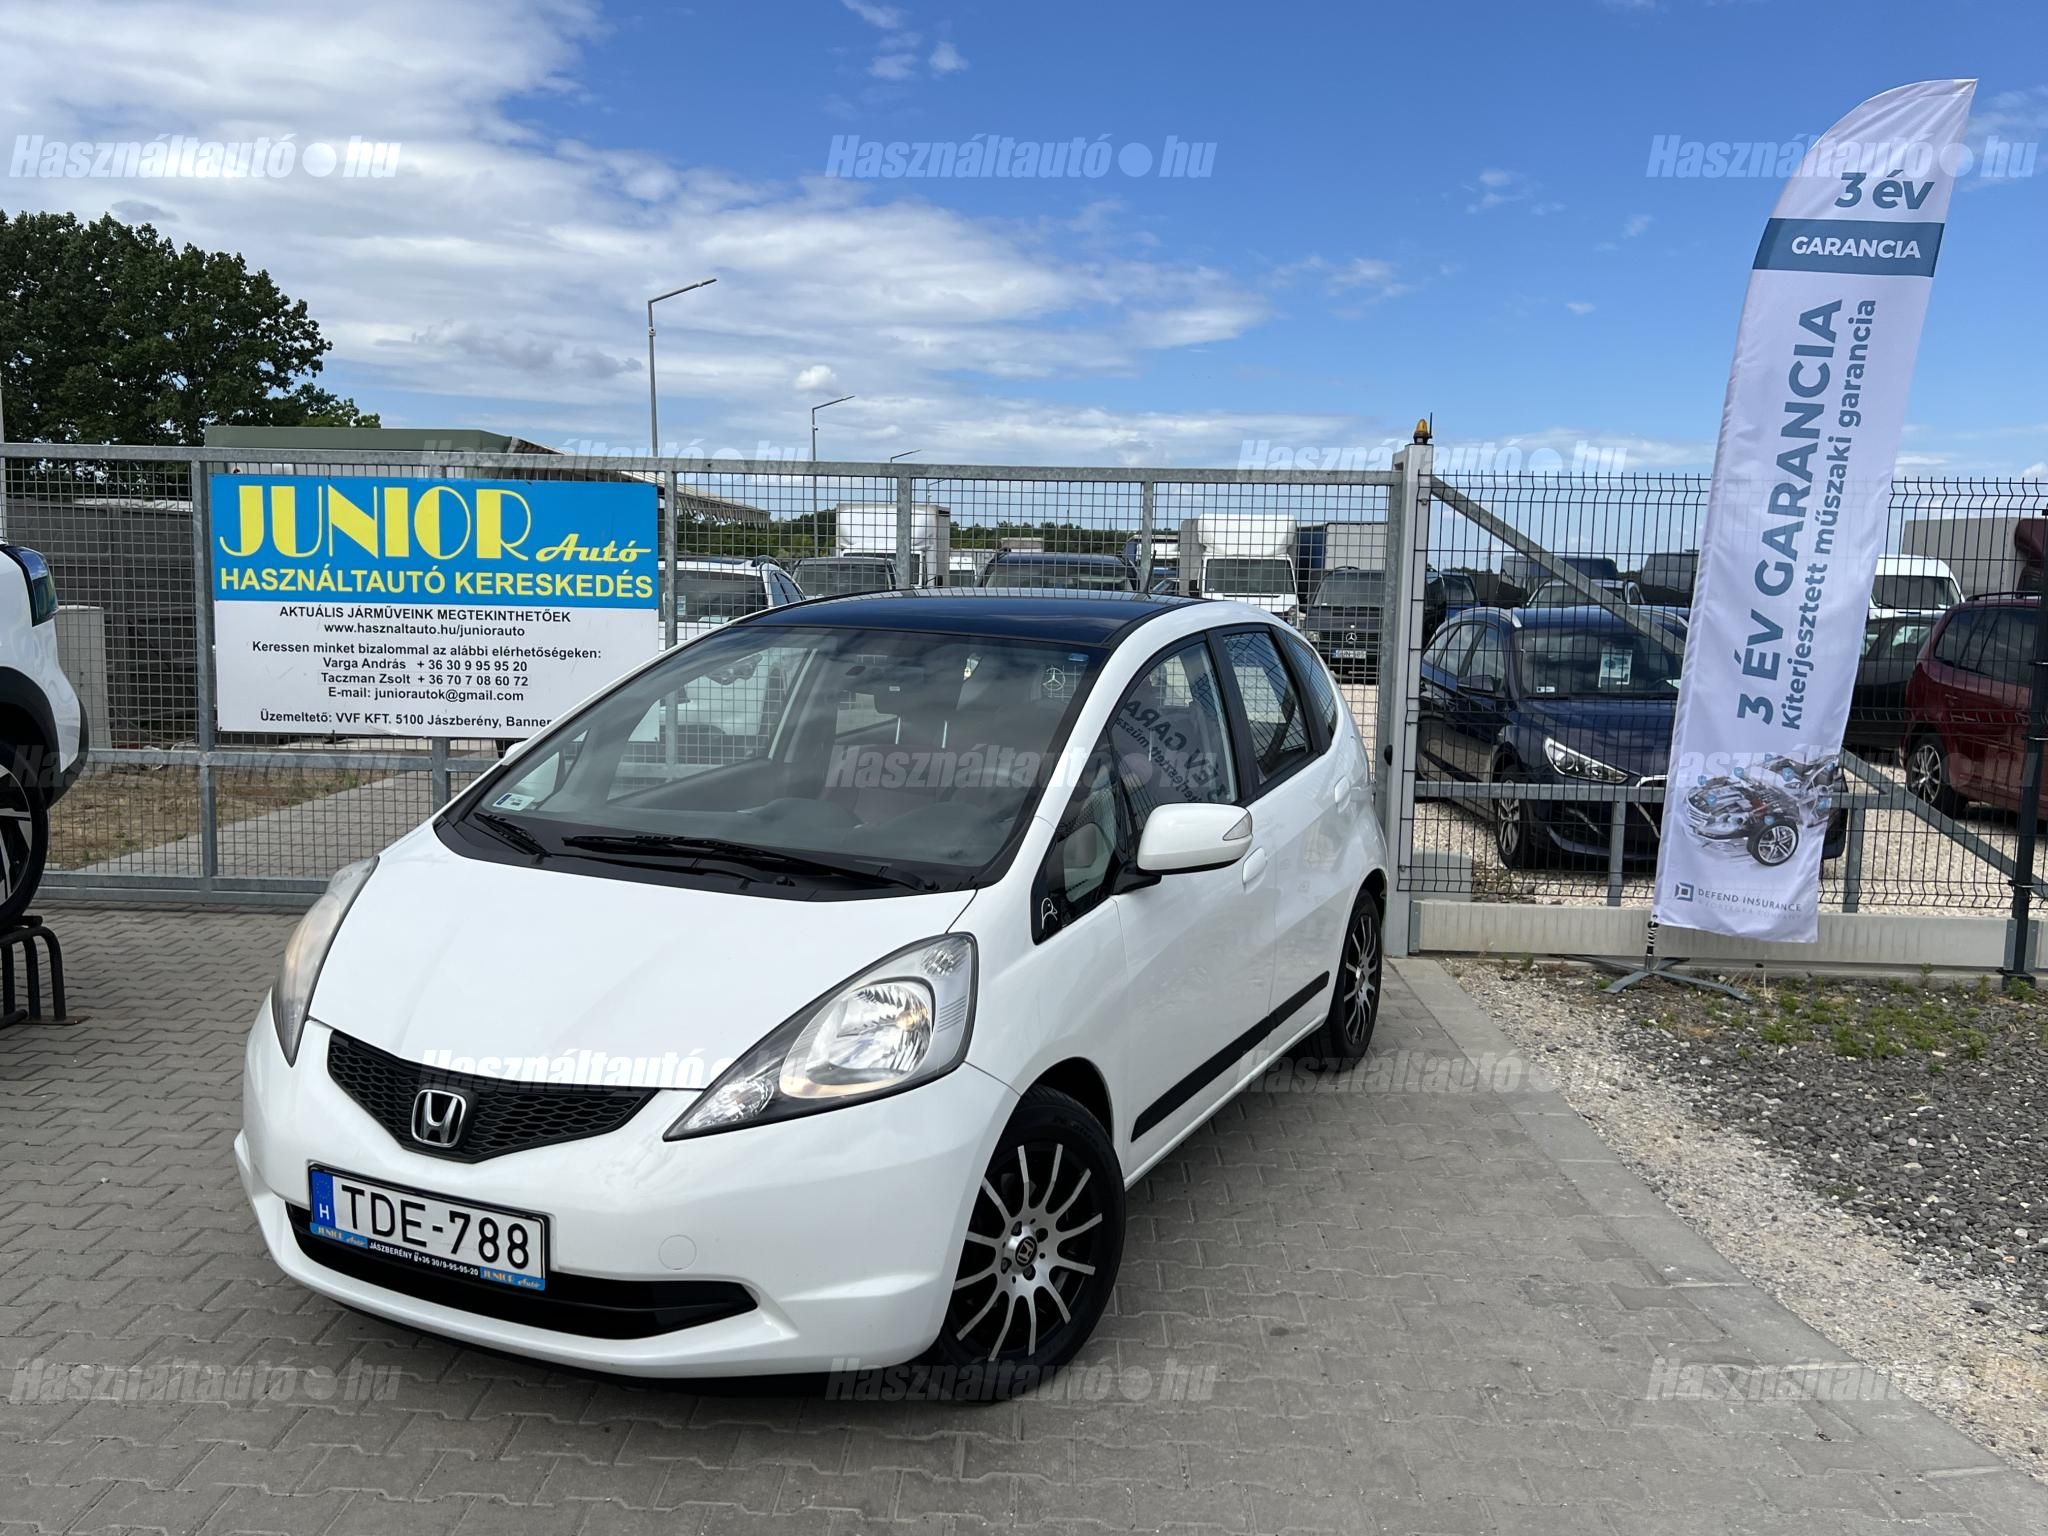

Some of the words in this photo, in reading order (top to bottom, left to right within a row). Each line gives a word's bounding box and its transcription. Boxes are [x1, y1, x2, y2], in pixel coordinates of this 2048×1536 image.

[1834, 171, 1866, 208] 3
[1872, 169, 1935, 210] év
[1791, 236, 1921, 259] GARANCIA
[1754, 299, 1843, 597] GARANCIA
[219, 484, 532, 561] JUNIOR
[536, 533, 652, 563] Autó
[1782, 563, 1828, 730] Kiterjesztett
[1815, 436, 1852, 554] műszaki
[1839, 300, 1876, 428] garancia
[220, 565, 446, 595] HASZNÁLTAUTÓ
[456, 569, 653, 599] KERESKEDÉS
[280, 605, 344, 619] AKTUÁLIS
[347, 606, 433, 621] JÁRMŰVEINK
[437, 608, 571, 623] MEGTEKINTHETŐEK
[324, 622, 526, 637] www.hasznaltauto.hu/juniorauto
[252, 641, 310, 654] Keressen
[313, 642, 355, 655] minket
[358, 643, 429, 656] bizalommal
[433, 647, 447, 657] az
[450, 644, 488, 657] alábbi
[492, 645, 601, 662] elérhetőségeken:
[1734, 608, 1784, 681] ÉV
[323, 658, 359, 671] Varga
[361, 657, 406, 671] András
[428, 660, 443, 671] 36
[446, 660, 461, 671] 30
[464, 661, 472, 671] 9
[475, 661, 490, 671] 95
[493, 661, 509, 672] 95
[512, 661, 527, 672] 20
[321, 673, 376, 685] Taczman
[379, 673, 410, 685] Zsolt
[428, 674, 443, 686] 36
[447, 674, 462, 686] 70
[464, 675, 471, 686] 7
[475, 675, 491, 686] 08
[493, 675, 510, 686] 60
[513, 675, 529, 687] 72
[328, 687, 371, 699] E-mail:
[374, 687, 524, 702] juniorautok@gmail.com
[260, 709, 333, 724] Üzemeltető:
[336, 712, 361, 724] VVF
[364, 713, 392, 725] KFT.
[396, 713, 424, 725] 5100
[427, 713, 502, 729] Jászberény,
[506, 716, 553, 728] Banner
[1737, 693, 1774, 725] 3
[1698, 888, 1739, 903] DEFEND
[1743, 895, 1801, 912] INSURANCE
[341, 1184, 529, 1269] TDE-788
[369, 1241, 413, 1259] JÁSZBERÉNY
